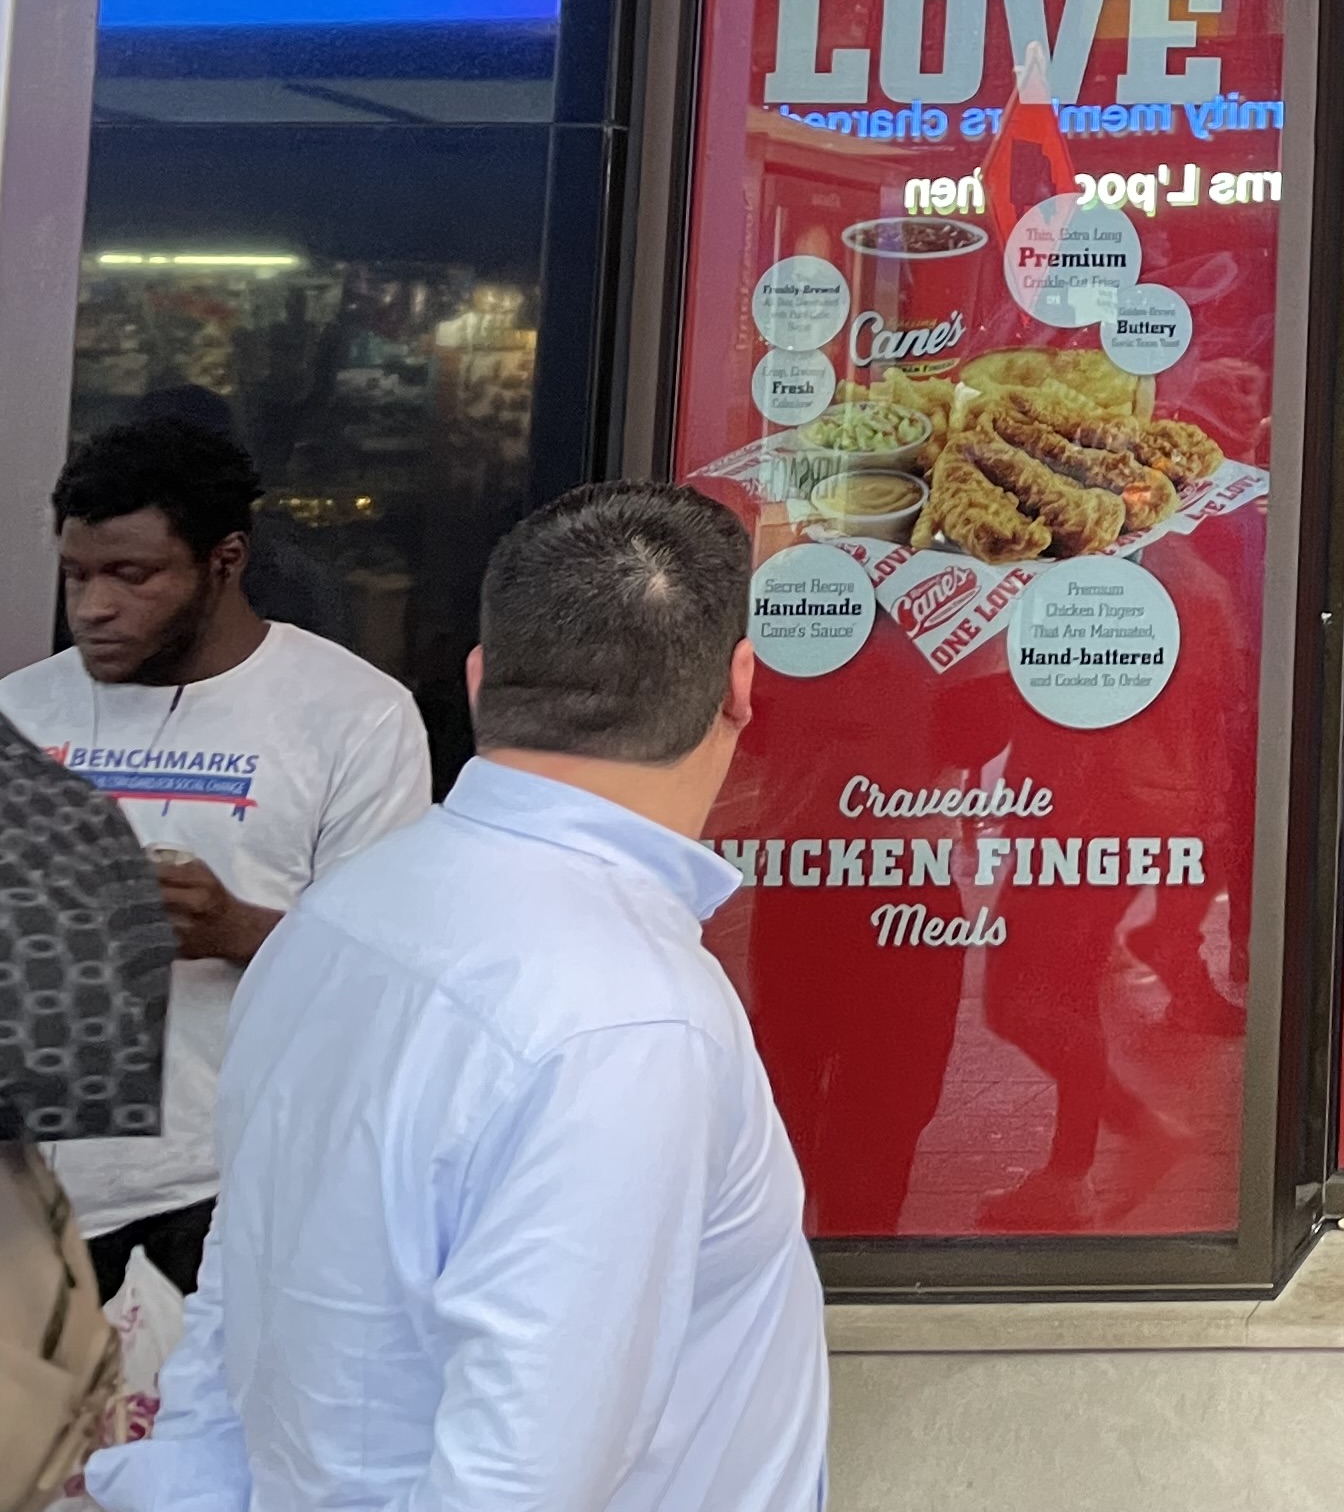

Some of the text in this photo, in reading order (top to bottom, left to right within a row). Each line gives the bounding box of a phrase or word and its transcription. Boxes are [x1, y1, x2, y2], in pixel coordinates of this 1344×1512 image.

[1018, 246, 1127, 269] Premium
[850, 309, 967, 367] Cane's
[1116, 320, 1177, 338] Buttery
[772, 380, 815, 395] Fresh
[754, 598, 863, 616] Handmade
[930, 567, 1036, 668] ONE LOVE
[761, 622, 807, 639] Cane's
[1020, 647, 1165, 666] Hand-battered
[68, 747, 260, 775] BENCHMARKS
[838, 774, 1054, 819] Craveable
[704, 836, 1206, 887] HICKEN FINGER
[870, 902, 1008, 948] Meals
